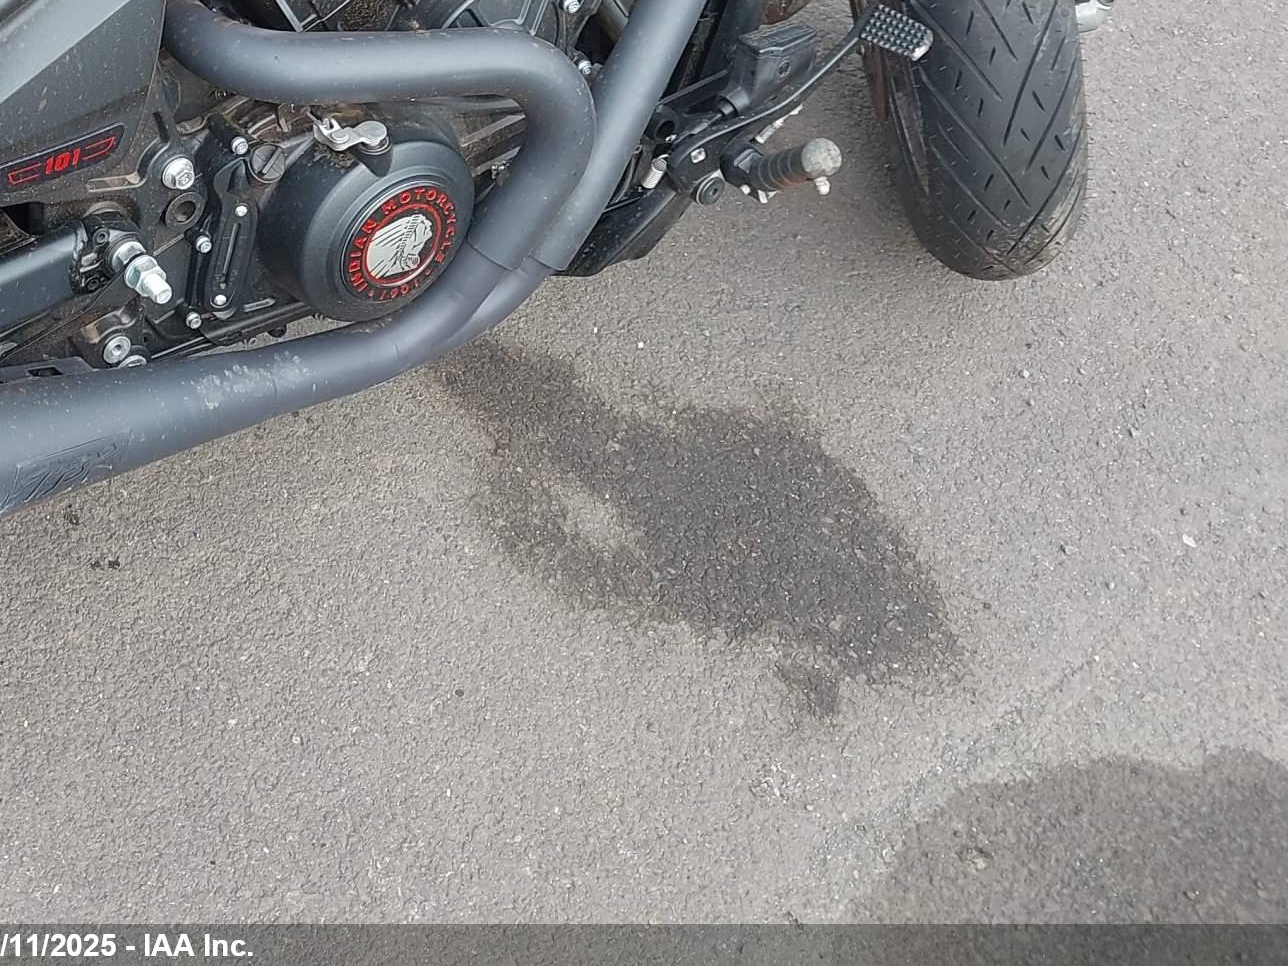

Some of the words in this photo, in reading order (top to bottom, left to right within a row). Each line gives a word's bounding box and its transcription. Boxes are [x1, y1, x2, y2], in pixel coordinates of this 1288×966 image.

[44, 147, 81, 175] 101
[347, 218, 378, 293] INDIAN
[381, 187, 457, 263] MOTORCYCLE
